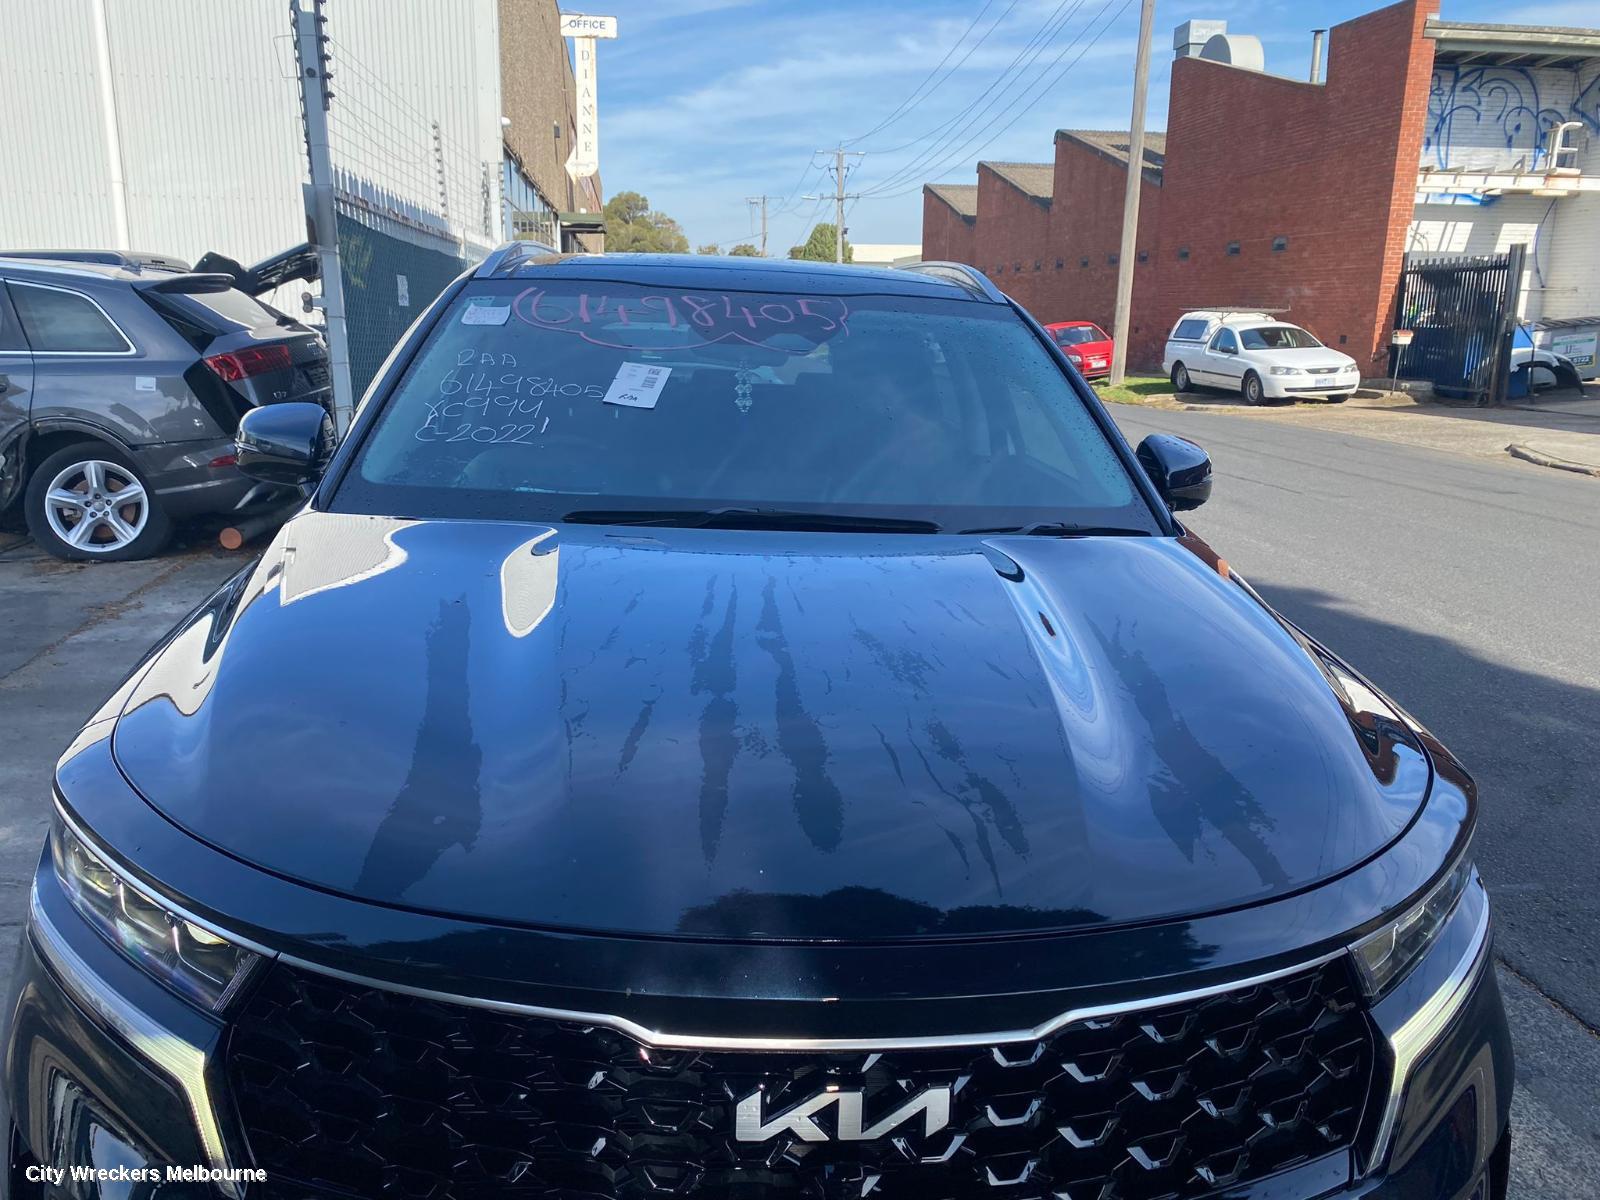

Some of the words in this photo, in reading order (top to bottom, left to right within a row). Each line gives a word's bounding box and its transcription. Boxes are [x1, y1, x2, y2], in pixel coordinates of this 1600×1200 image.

[568, 19, 606, 30] OFFICE
[581, 50, 593, 153] DIANNE
[439, 369, 605, 398] 61498405
[736, 1087, 950, 1141] KIA
